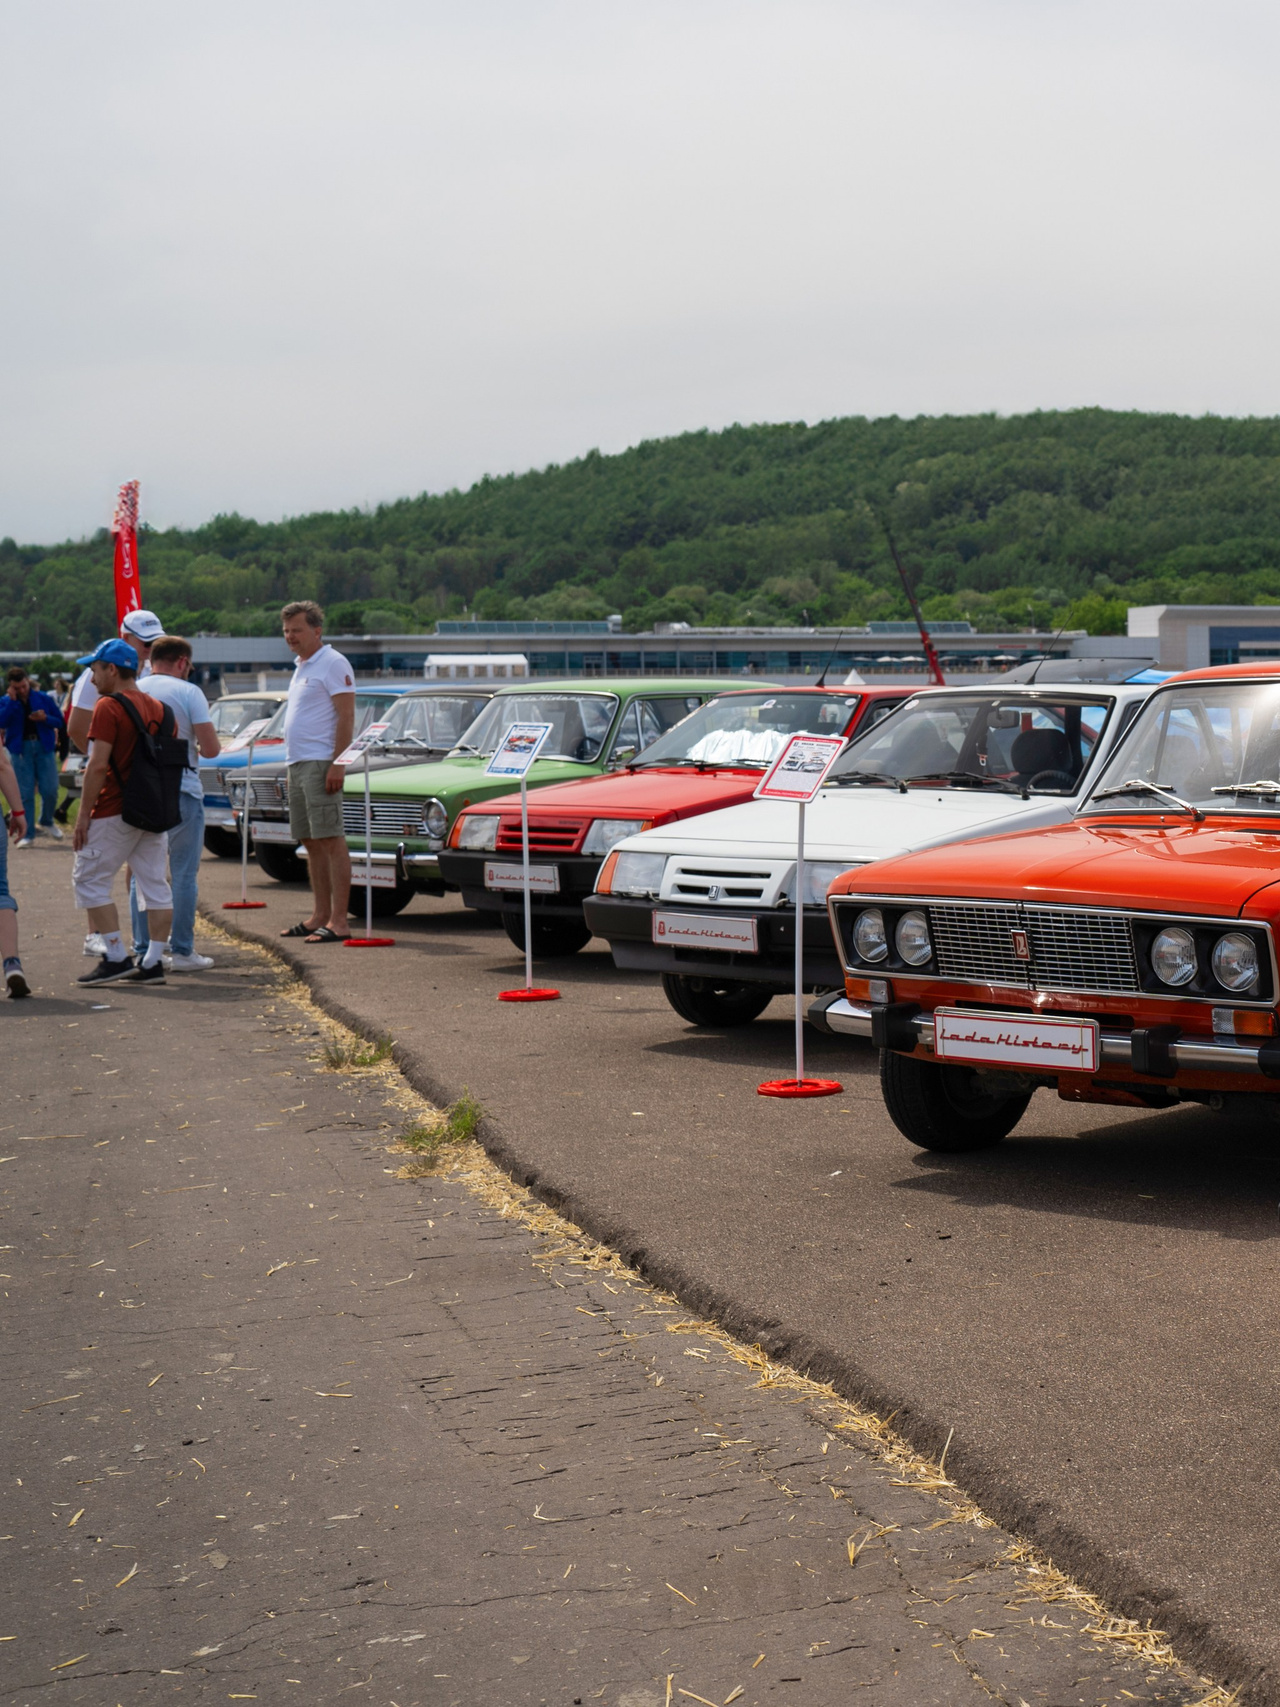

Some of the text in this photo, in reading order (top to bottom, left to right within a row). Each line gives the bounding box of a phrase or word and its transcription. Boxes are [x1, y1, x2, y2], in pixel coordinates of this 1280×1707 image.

[519, 875, 555, 884] Hstory
[668, 926, 751, 942] Lada History
[940, 1028, 1089, 1055] Lada History
